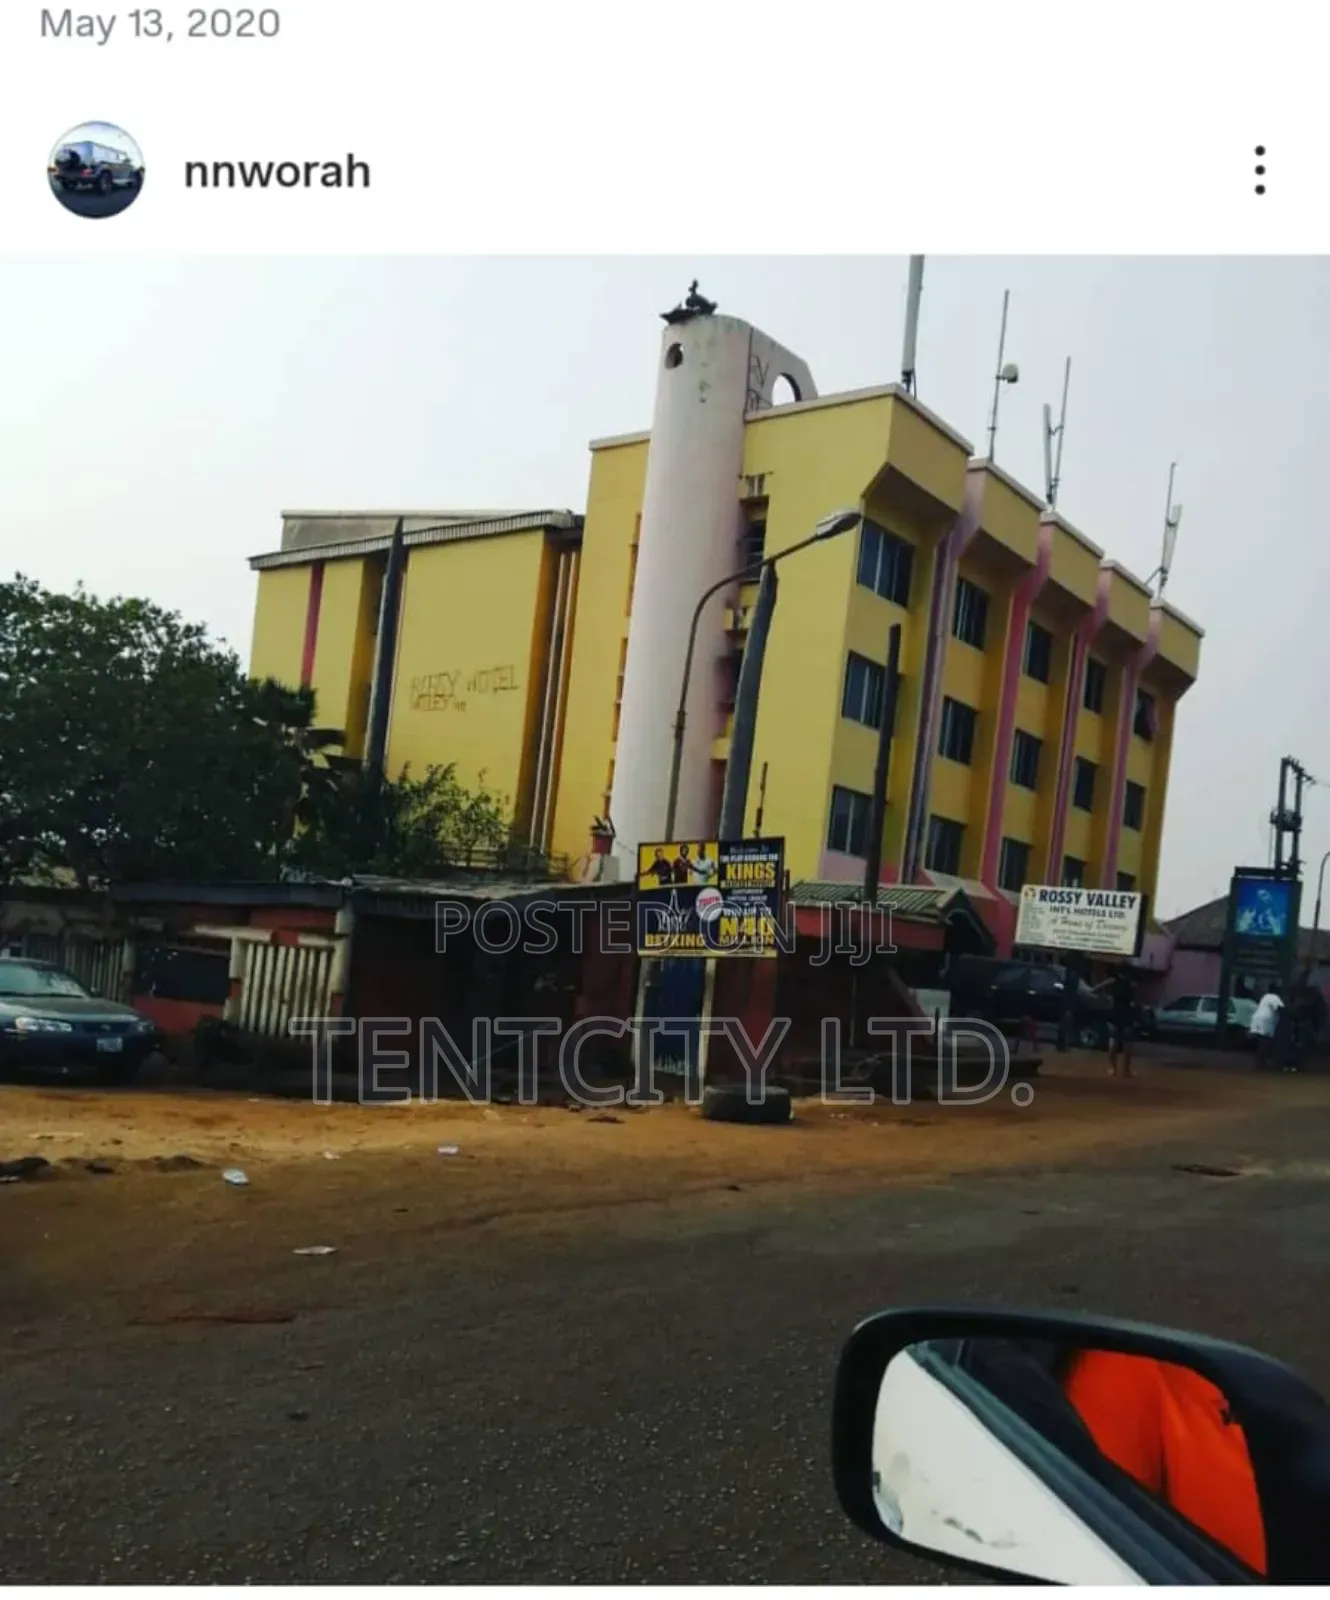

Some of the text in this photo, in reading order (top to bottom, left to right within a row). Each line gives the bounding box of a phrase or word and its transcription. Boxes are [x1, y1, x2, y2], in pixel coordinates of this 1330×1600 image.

[726, 862, 776, 881] KINGS
[1038, 889, 1137, 909] ROSSY VALLEY
[1073, 908, 1106, 918] HOTELS
